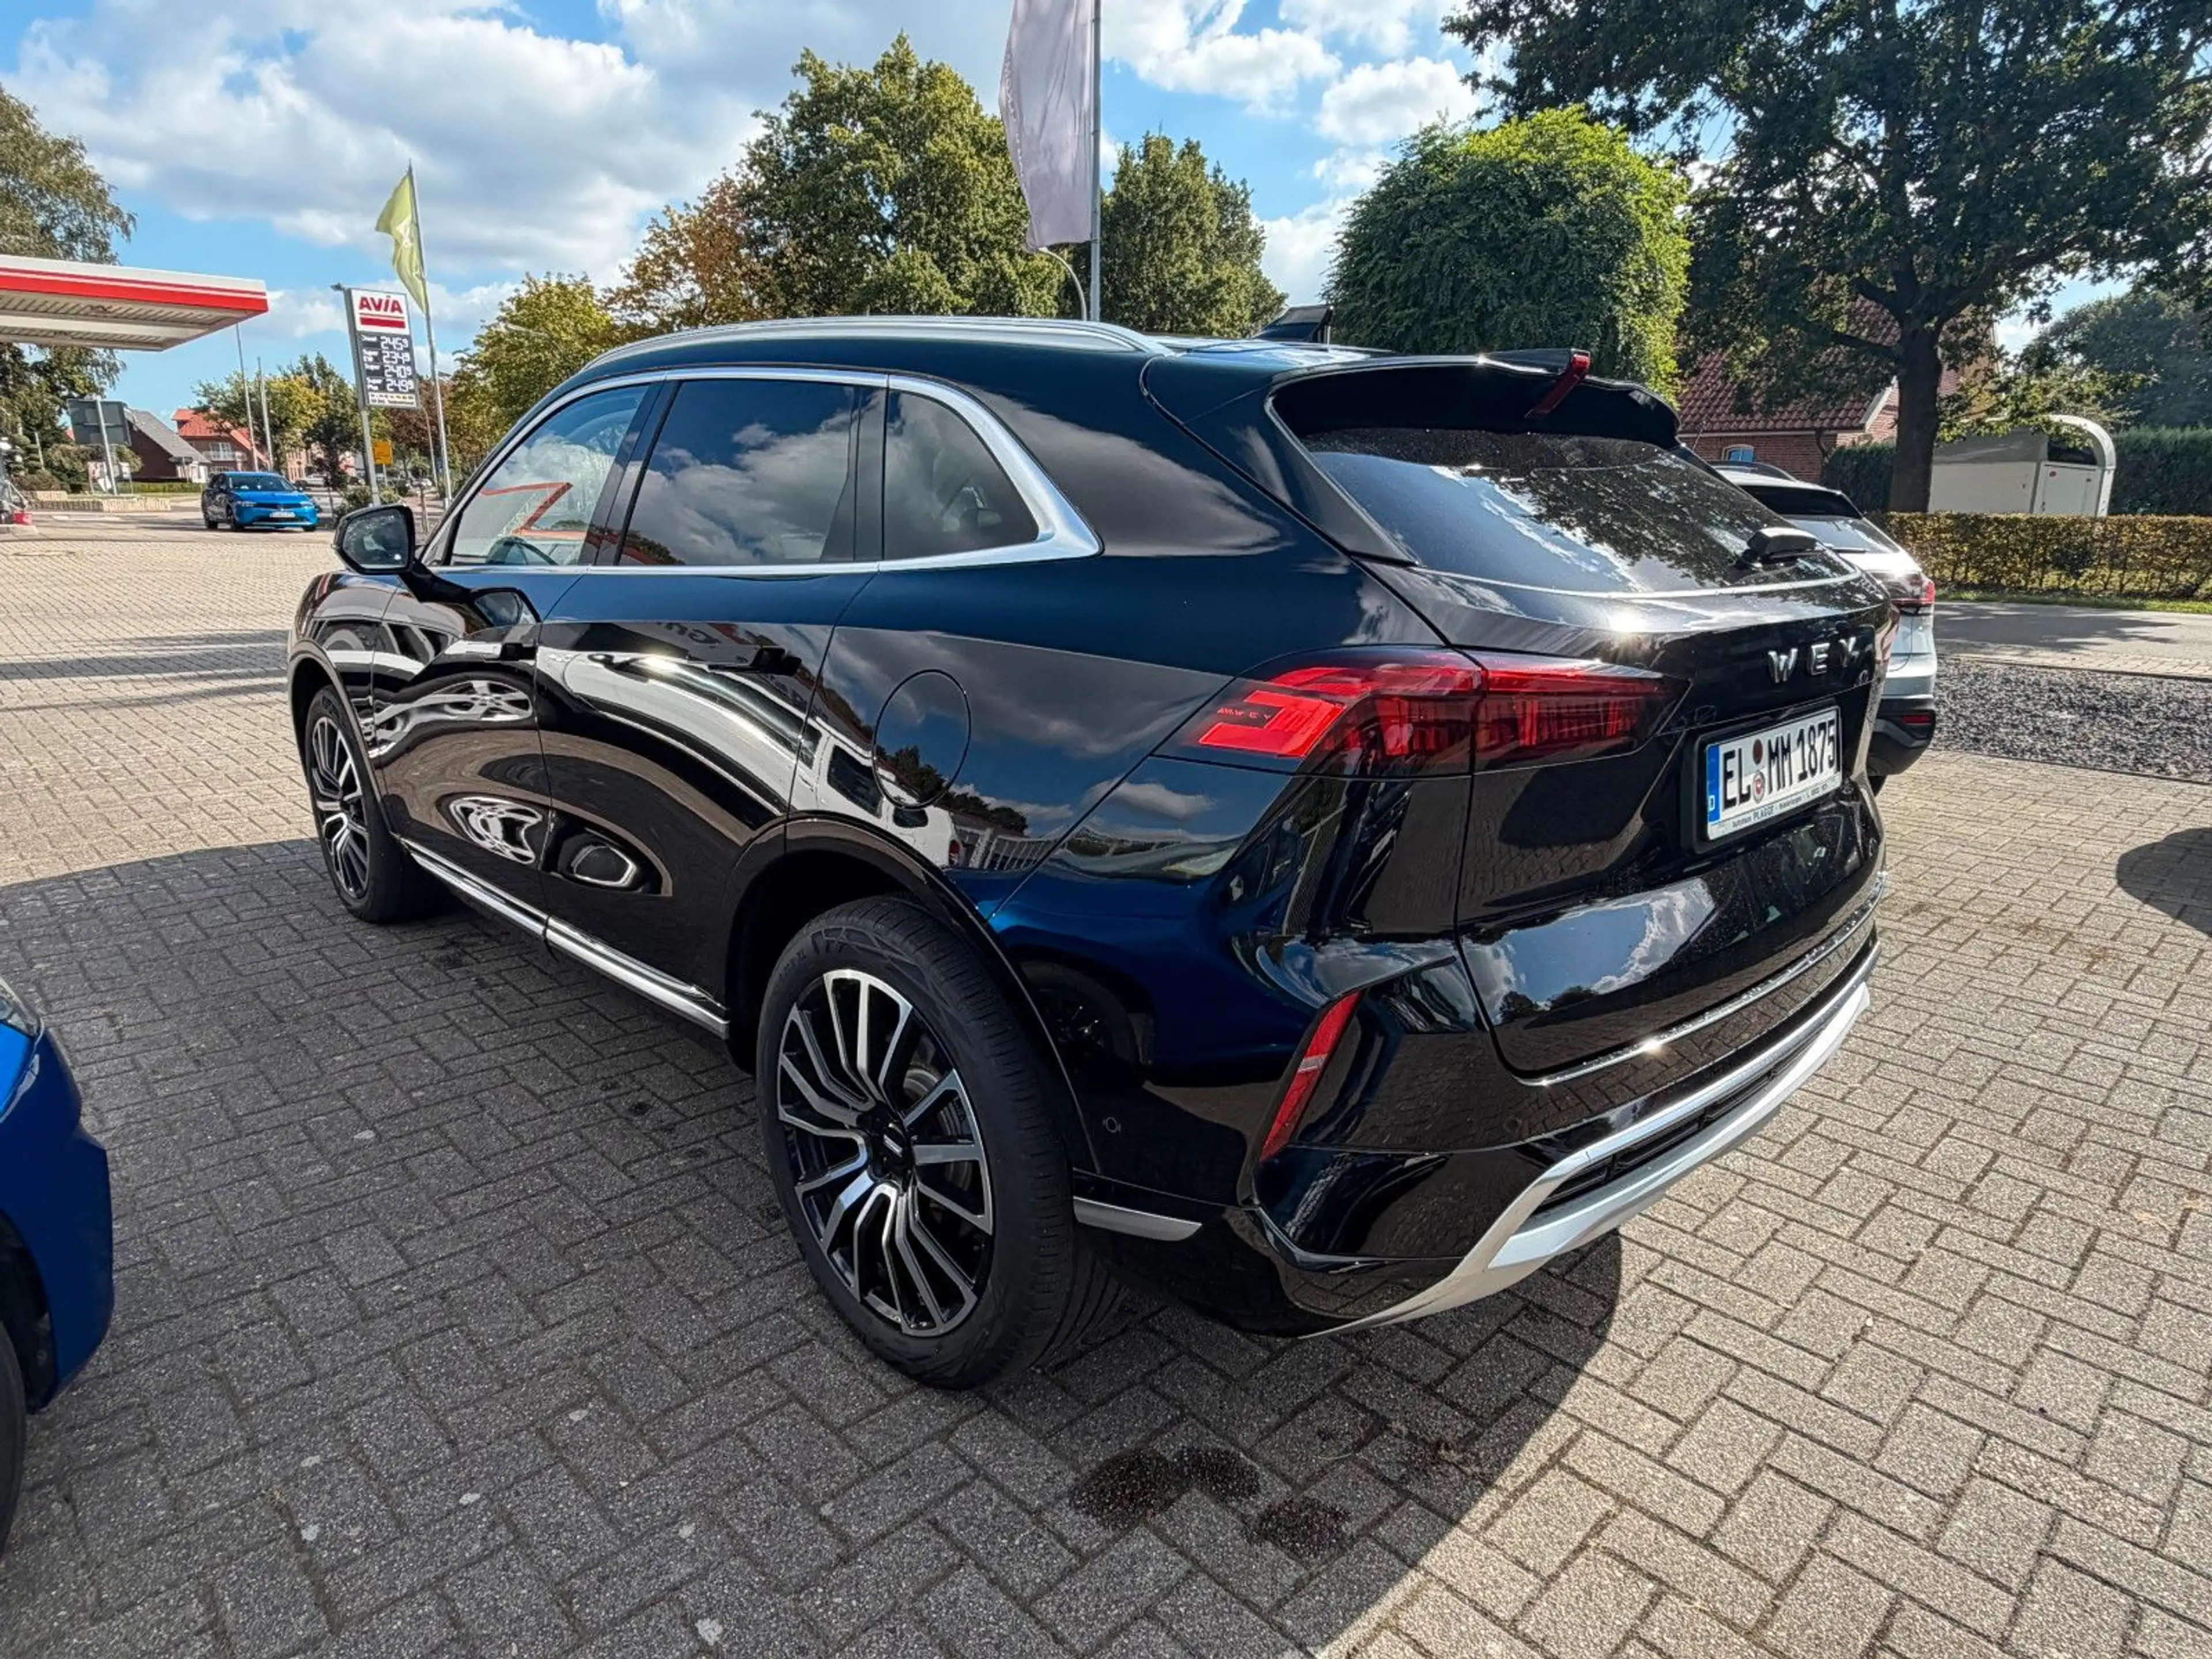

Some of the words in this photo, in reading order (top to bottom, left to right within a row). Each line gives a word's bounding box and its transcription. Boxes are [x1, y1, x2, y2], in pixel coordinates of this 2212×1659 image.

[359, 295, 403, 313] AVIA
[1768, 637, 1859, 683] WEY
[1722, 748, 1751, 812] EL
[1768, 732, 1793, 795] MM
[1797, 719, 1835, 783] 1875
